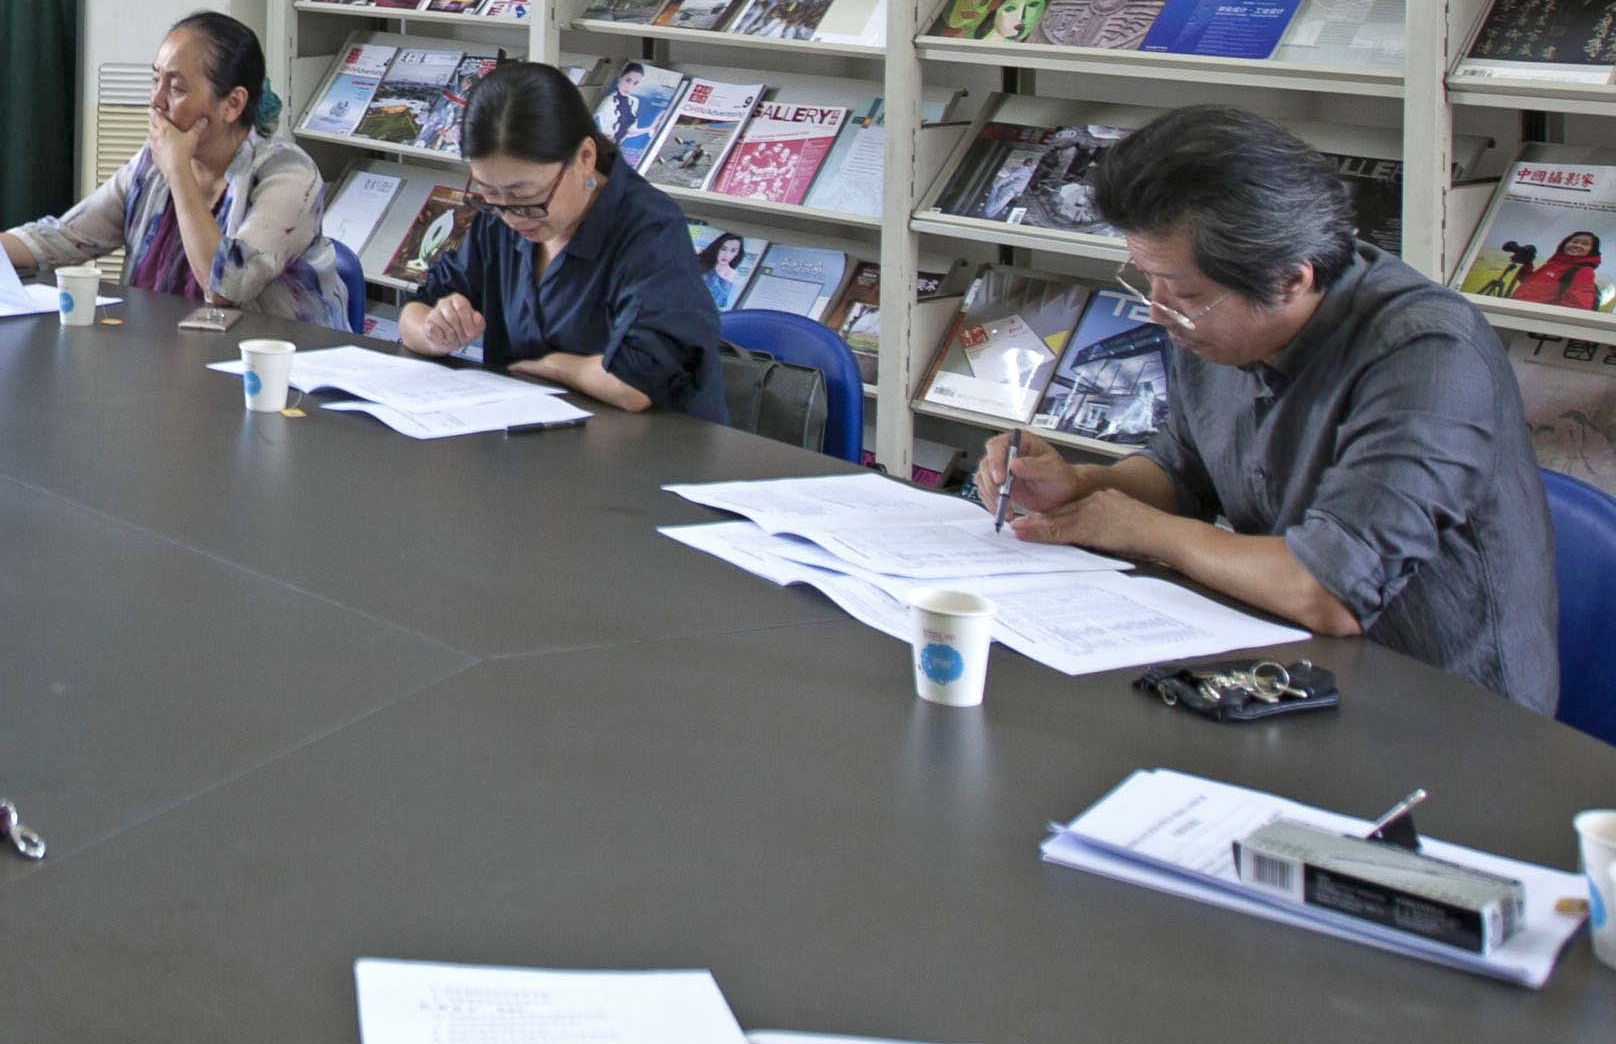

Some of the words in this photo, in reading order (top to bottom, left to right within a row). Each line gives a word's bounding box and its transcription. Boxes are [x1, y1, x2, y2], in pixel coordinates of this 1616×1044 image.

[743, 96, 754, 108] 9
[1517, 167, 1595, 188] 中國攝影家
